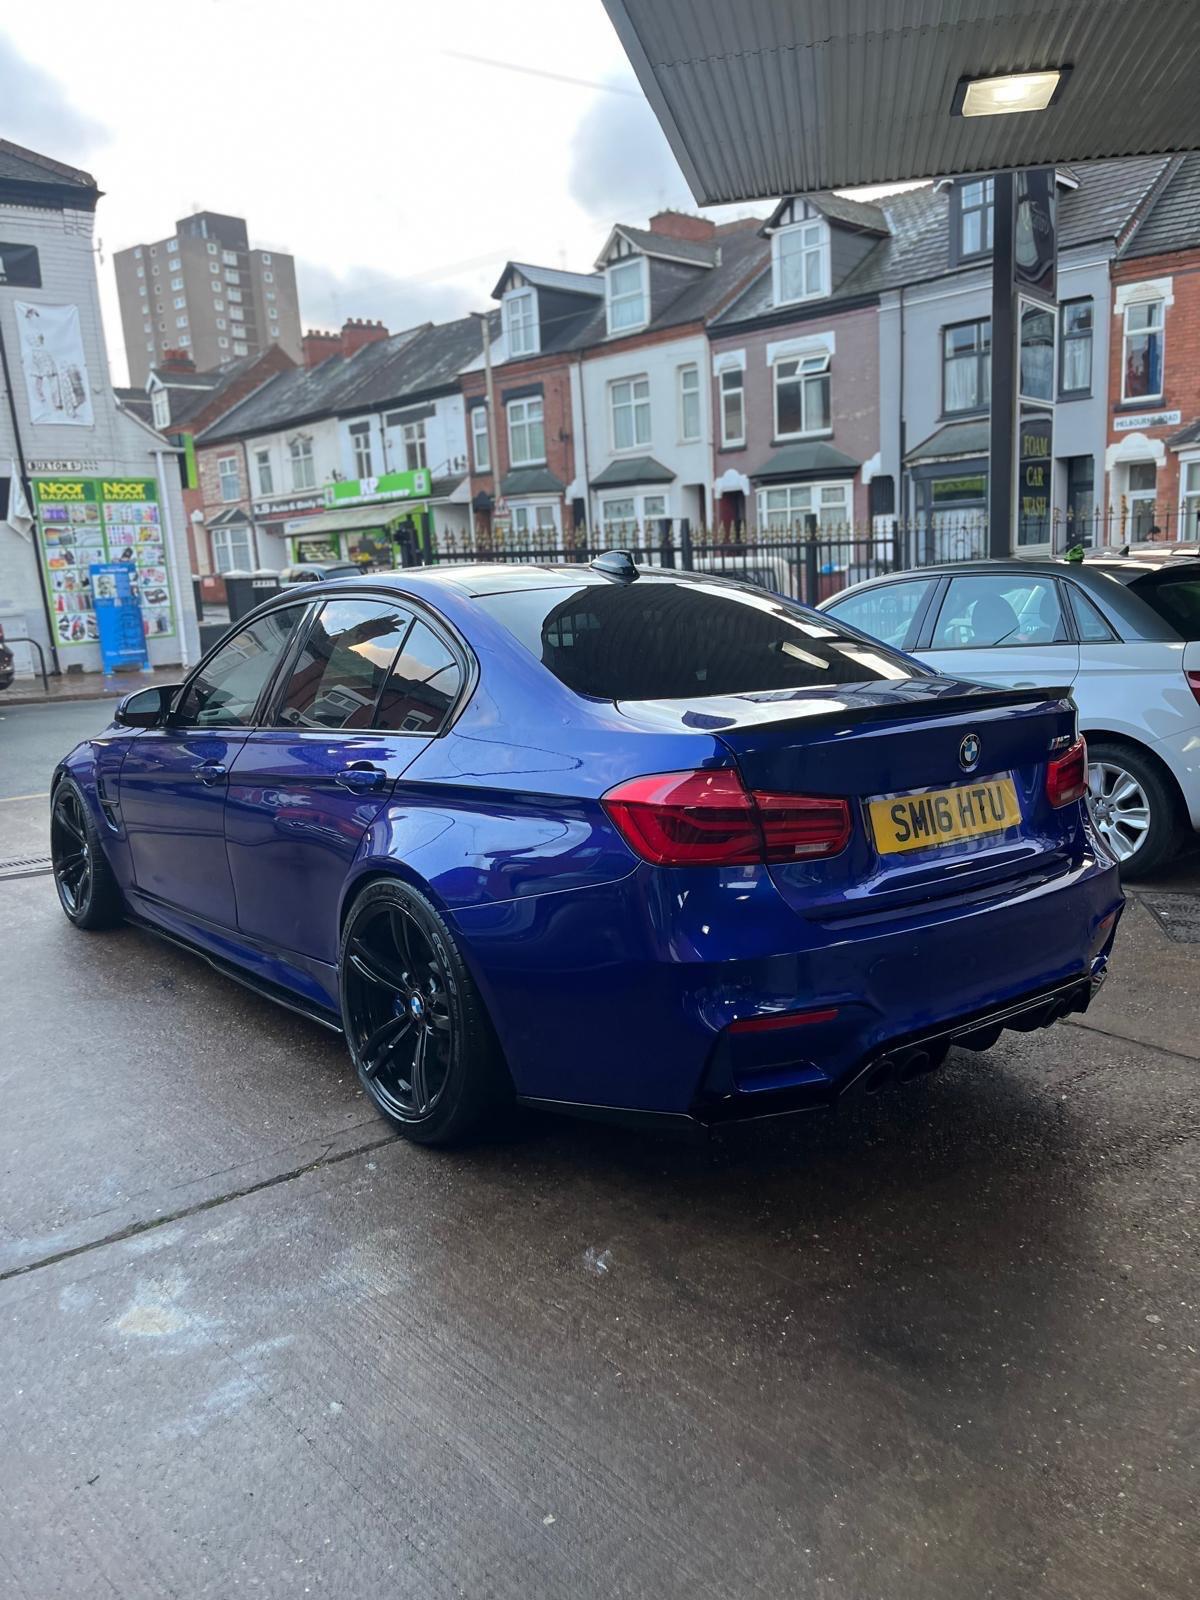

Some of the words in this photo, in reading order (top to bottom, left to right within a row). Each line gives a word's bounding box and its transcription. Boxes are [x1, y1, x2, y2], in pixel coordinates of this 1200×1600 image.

[1115, 416, 1155, 429] MELBOURNE
[1156, 412, 1179, 424] OAD
[1023, 435, 1048, 457] FOAM
[30, 461, 69, 471] BUXTON
[1026, 466, 1044, 487] CAR
[1023, 496, 1047, 517] WASH
[890, 796, 953, 842] SM16
[956, 786, 1006, 829] HTU
